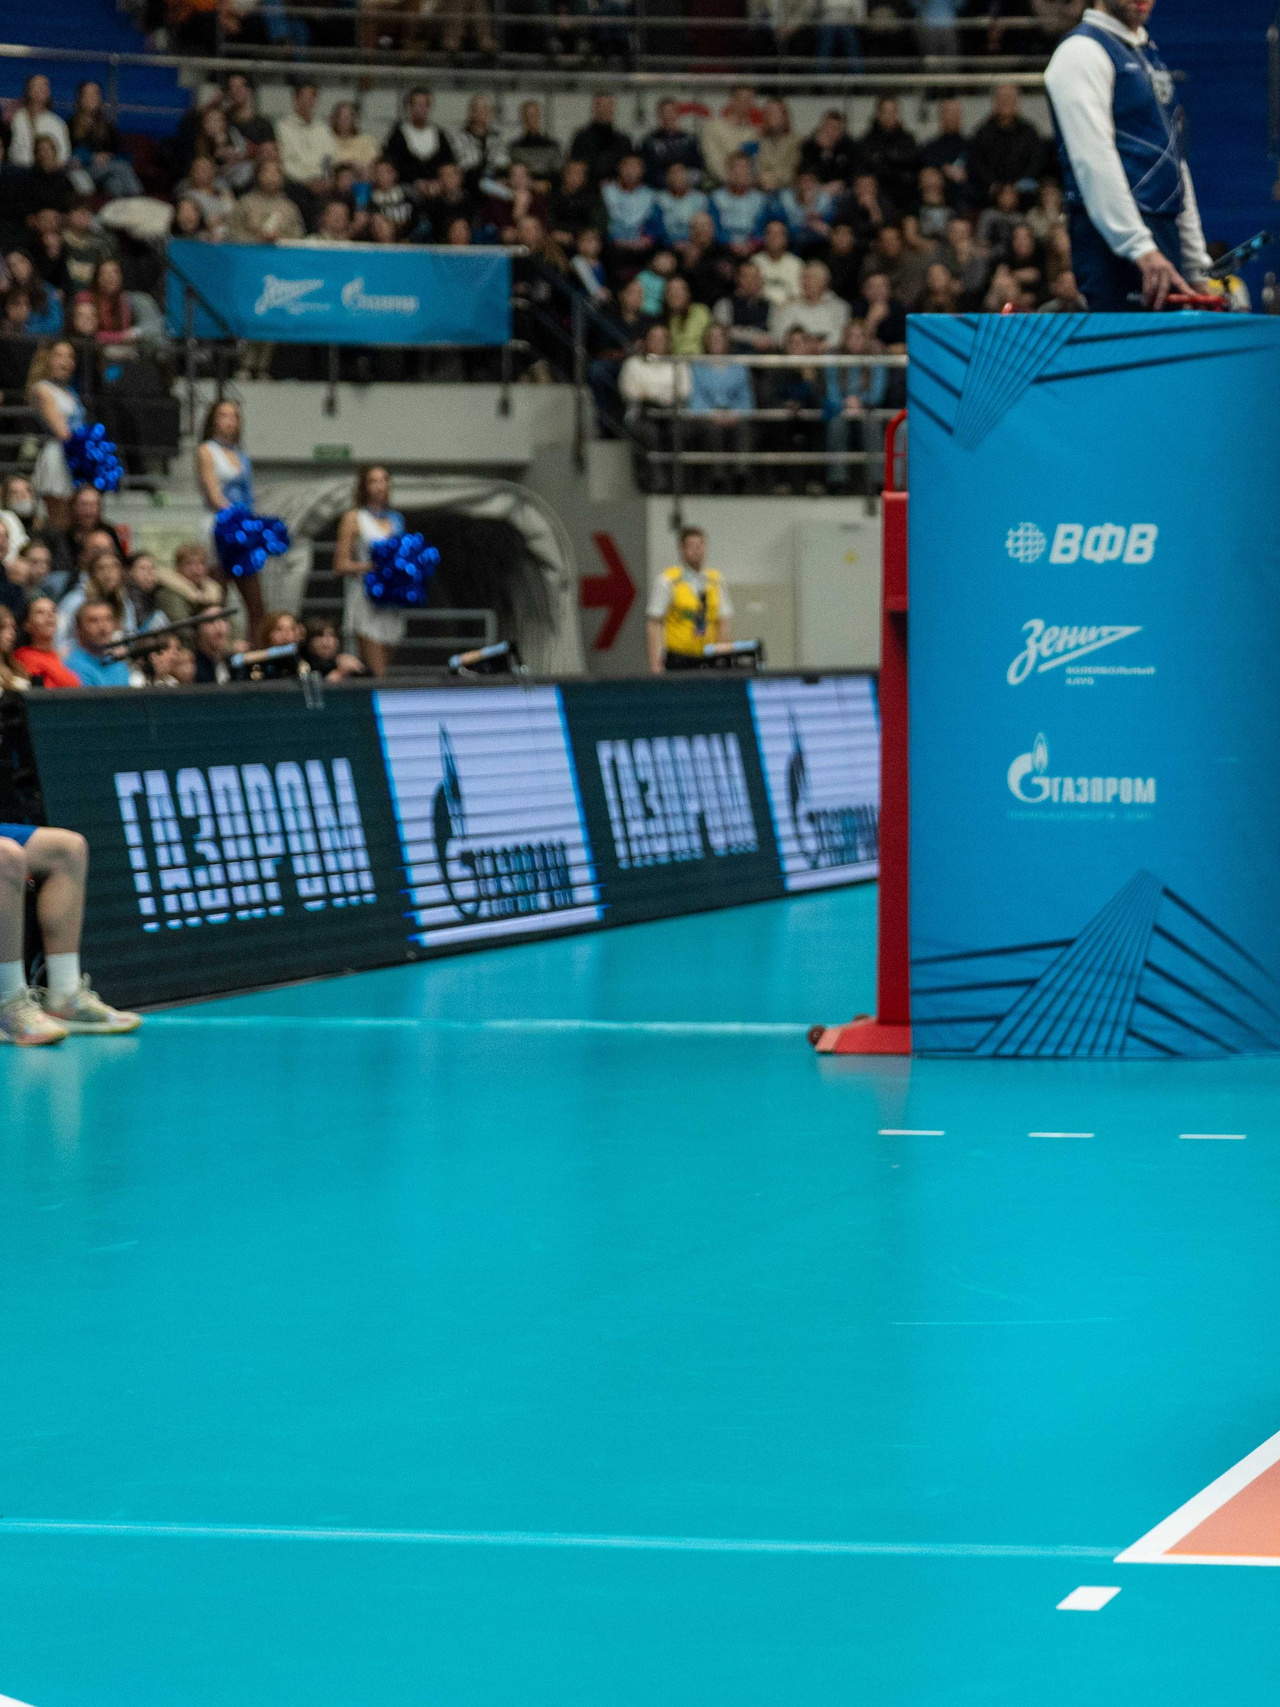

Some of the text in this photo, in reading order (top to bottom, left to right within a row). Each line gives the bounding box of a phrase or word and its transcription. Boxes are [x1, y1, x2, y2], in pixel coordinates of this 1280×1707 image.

[1049, 522, 1159, 565] ВФВ
[1006, 618, 1144, 686] Зенит
[596, 732, 760, 870] ГАЗПРОМ
[1051, 776, 1156, 804] ГАЗПРОМ
[113, 757, 378, 933] ГАЗПРОМ
